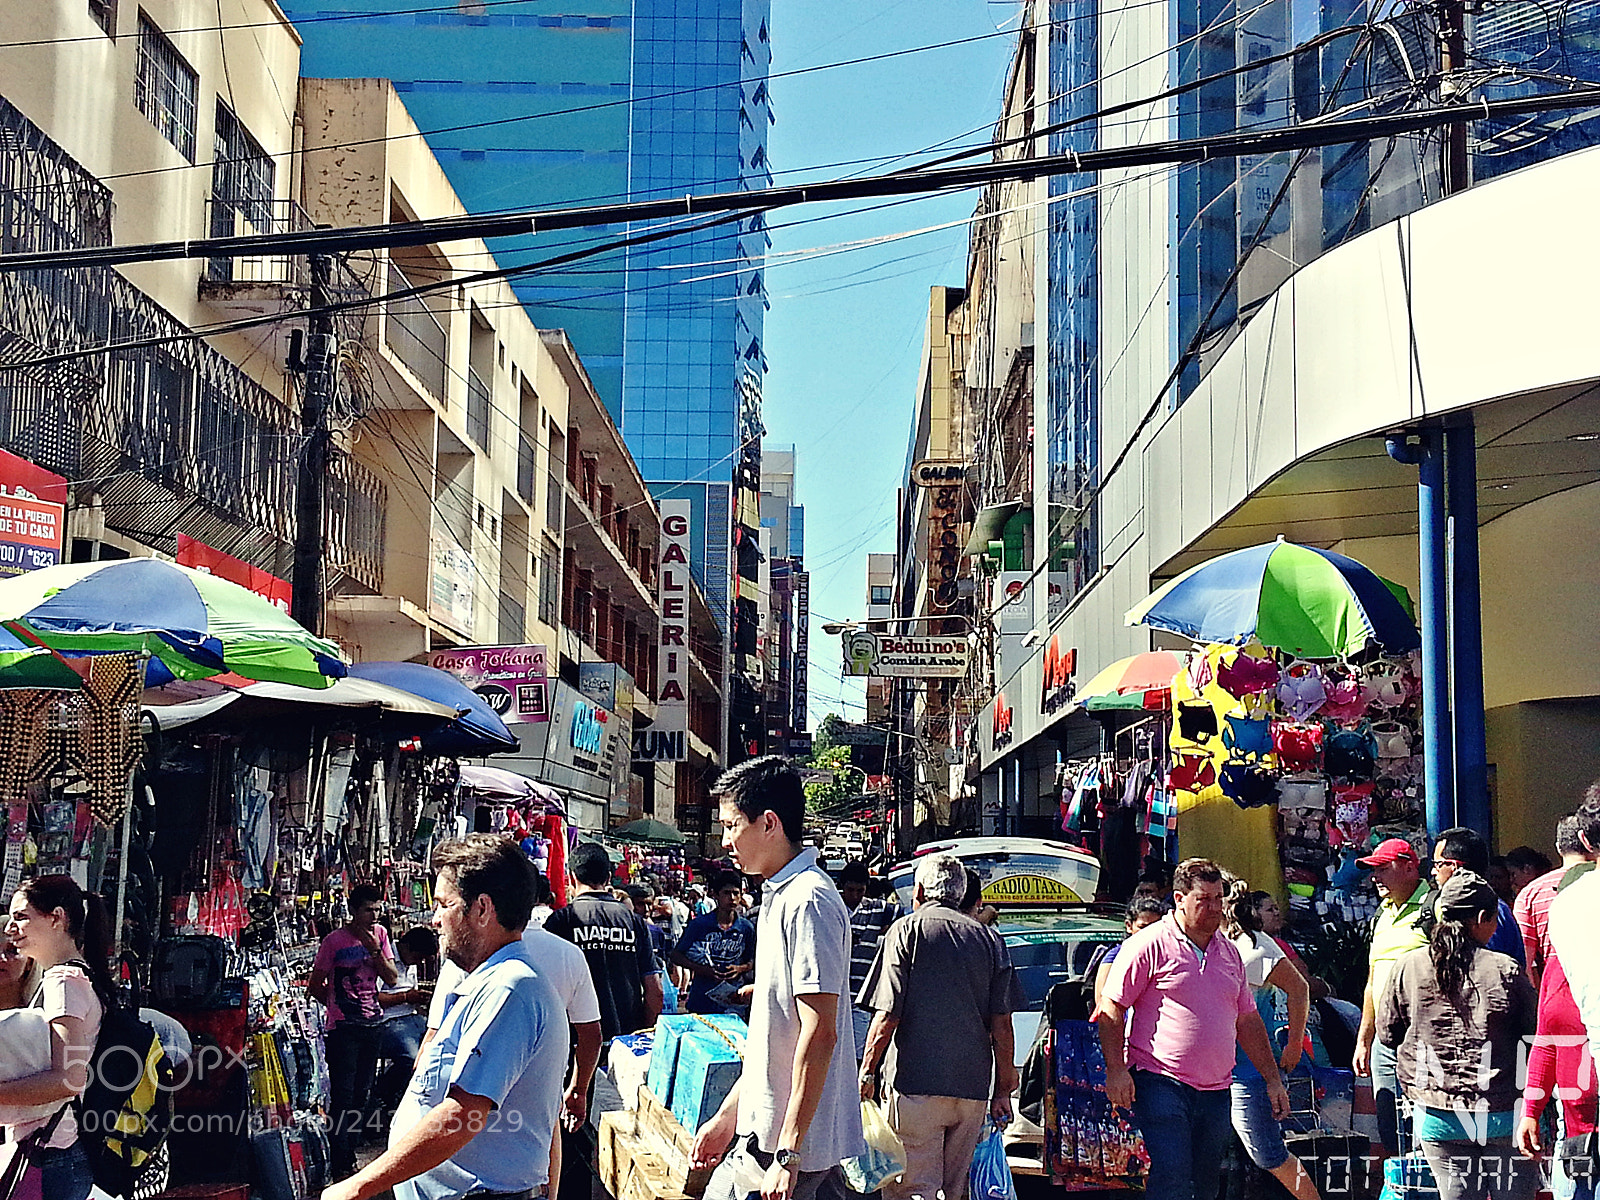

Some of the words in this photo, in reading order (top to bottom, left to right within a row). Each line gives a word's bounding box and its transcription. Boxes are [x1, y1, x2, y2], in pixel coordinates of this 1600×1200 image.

[13, 507, 24, 520] LA
[25, 509, 56, 525] PUERTA
[0, 518, 12, 533] DE
[15, 520, 28, 535] TU
[30, 523, 55, 540] CASA
[660, 515, 687, 701] GALERIA
[433, 654, 476, 669] Casa
[480, 650, 544, 670] Johana
[880, 656, 926, 666] Comida
[928, 656, 966, 666] Arabe
[993, 876, 1031, 894] RADIO
[1032, 877, 1062, 894] TAXI
